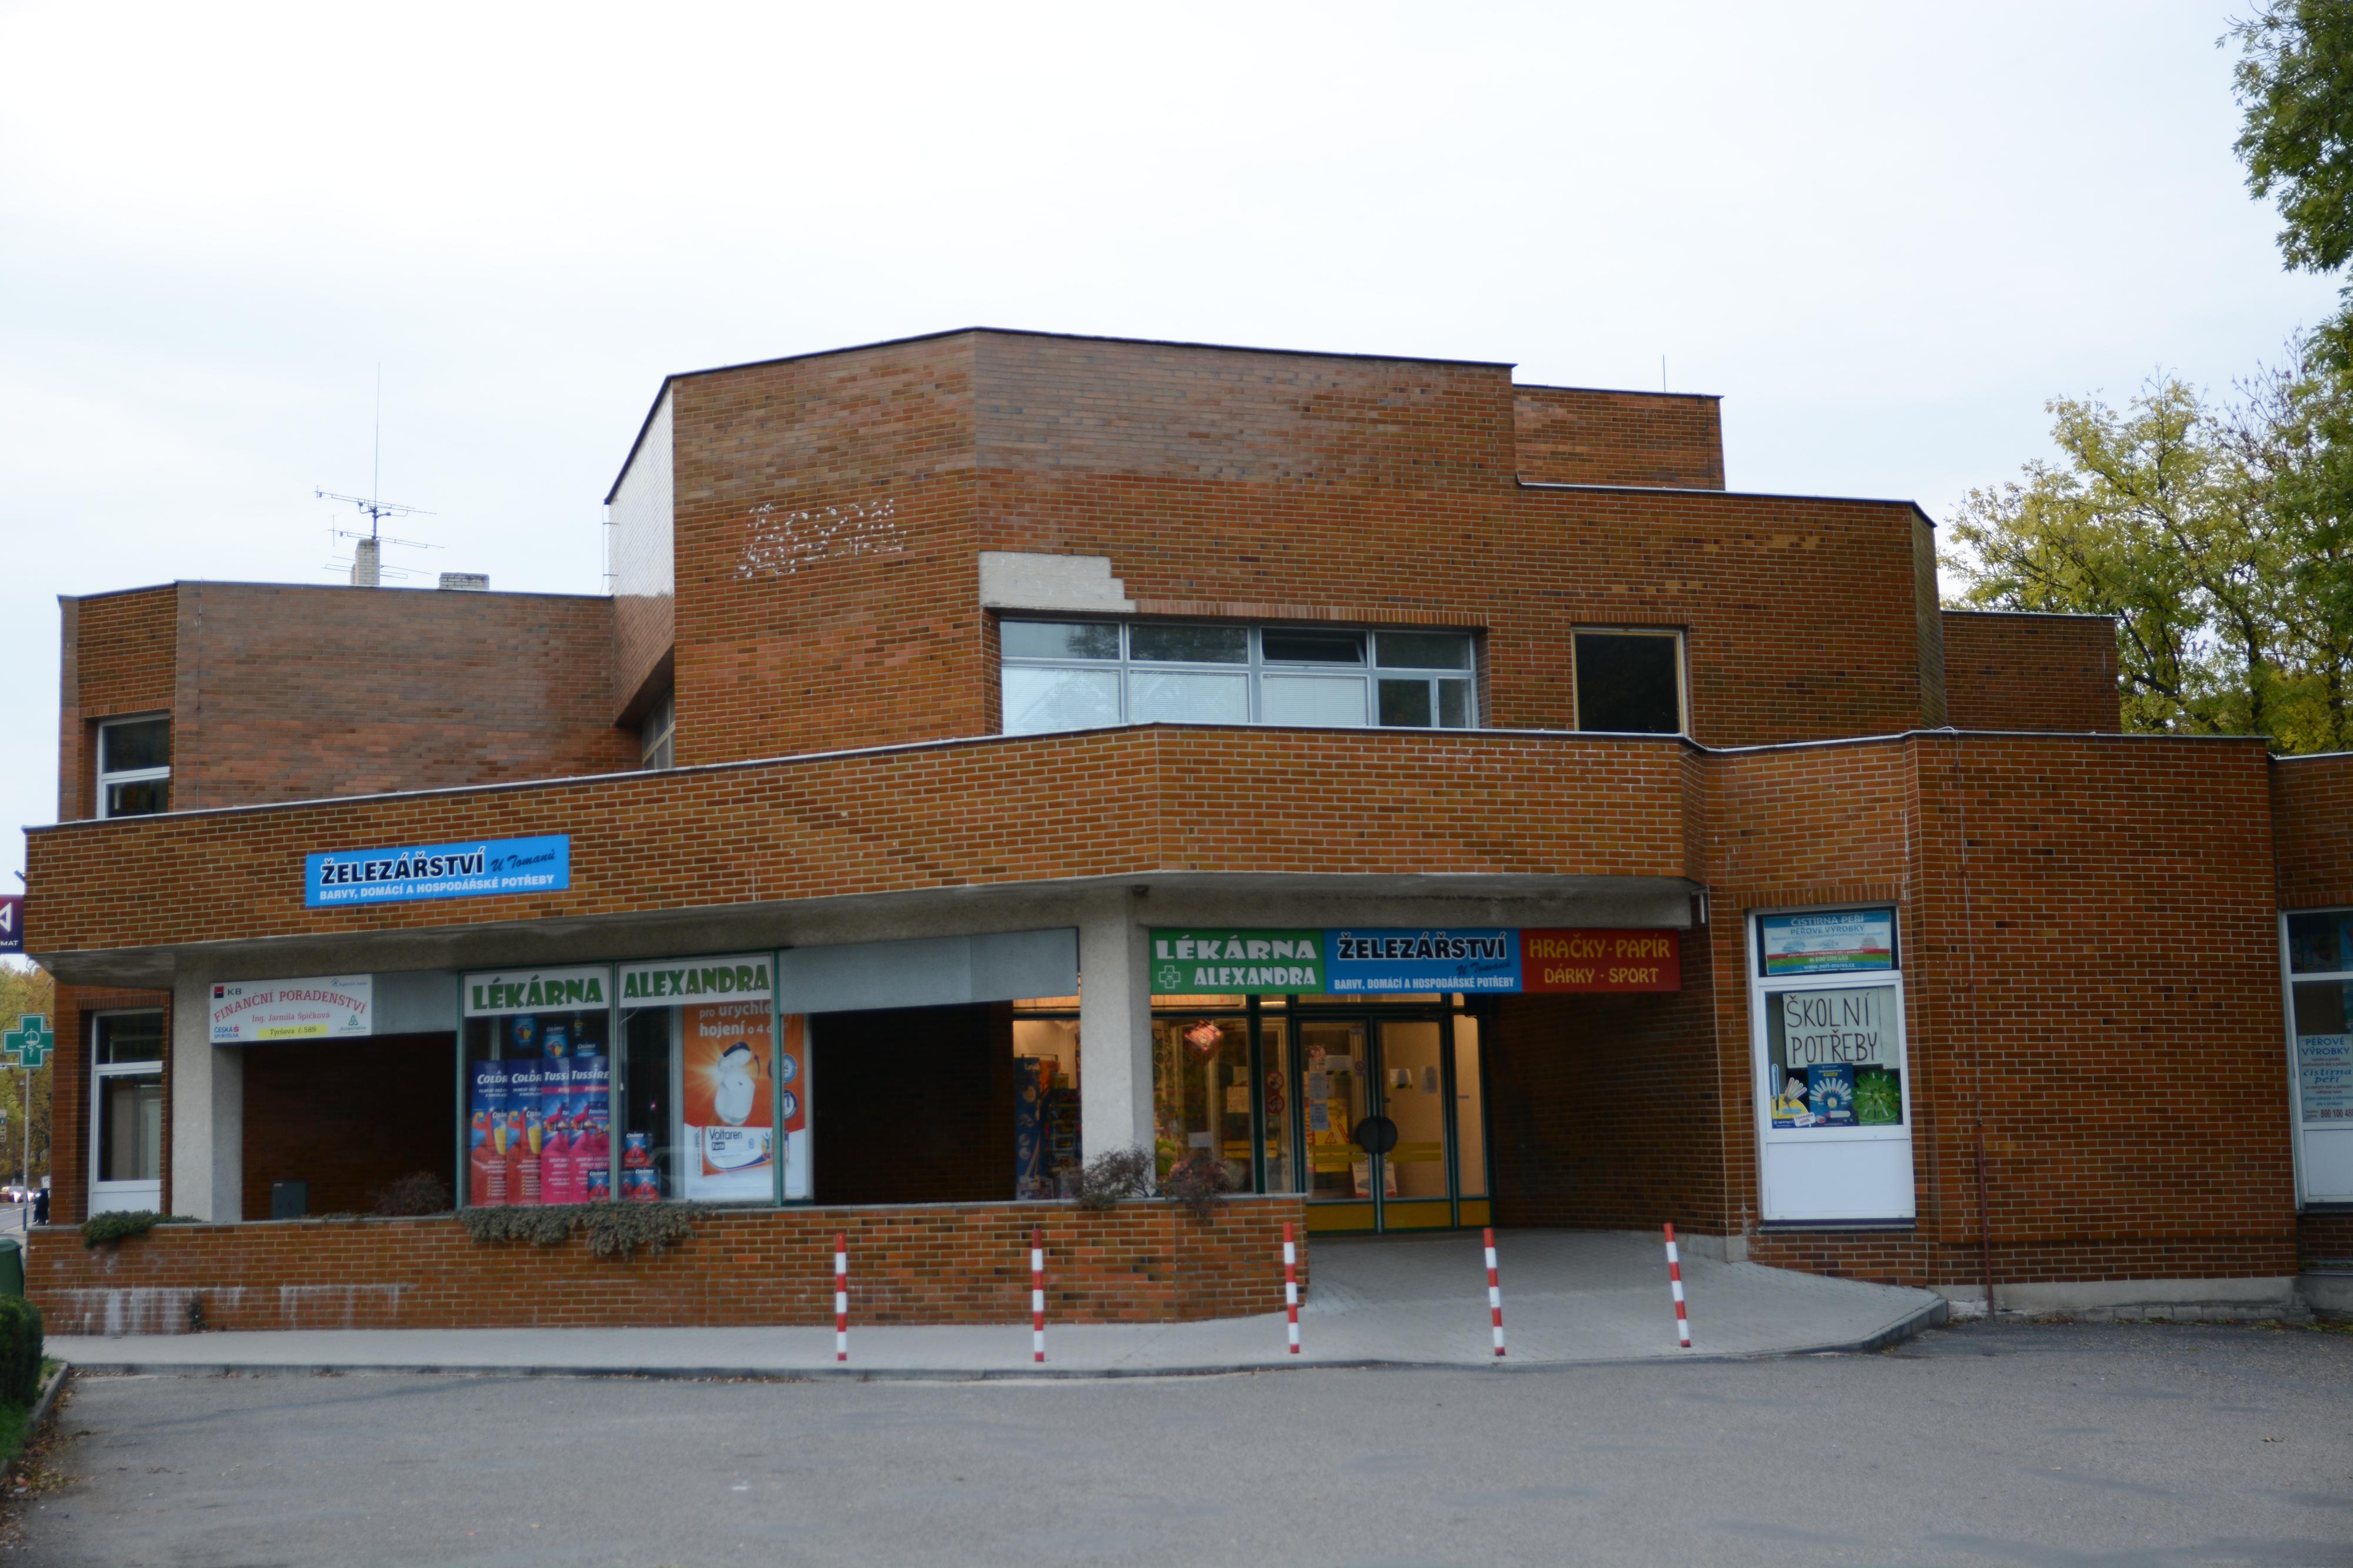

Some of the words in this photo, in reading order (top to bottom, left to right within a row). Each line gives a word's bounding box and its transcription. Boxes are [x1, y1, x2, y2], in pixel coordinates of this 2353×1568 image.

[321, 846, 486, 886] ŽELEZÁŘSTVÍ
[491, 858, 504, 872] U
[508, 849, 555, 869] Tomanů
[320, 889, 358, 900] BARVY,
[361, 883, 404, 897] DOMÁCÍ
[406, 885, 414, 893] A
[417, 877, 498, 893] HOSPODÁŘSKÉ
[501, 874, 555, 888] POTŘEBY
[1156, 935, 1317, 959] LÉKÁRNA
[1337, 932, 1507, 960] ŽELEZÁŘSTVÍ
[1194, 967, 1316, 985] ALEXANDRA
[1334, 979, 1365, 990] BARVY,
[1367, 976, 1402, 989] DOMÁCÍ
[1404, 979, 1411, 988] A
[1413, 975, 1475, 988] HOSPODÁŘSKÉ
[1477, 975, 1514, 987] POTŘEBY
[1544, 963, 1595, 983] DÁRKY
[1609, 968, 1659, 983] SPORT
[472, 974, 603, 1010] LÉKÁRNA
[624, 964, 770, 998] ALEXANDRA
[214, 989, 273, 1023] FINANČNÍ
[279, 990, 367, 1014] PORADENSTVÍ
[699, 1009, 715, 1019] pro
[1787, 992, 1871, 1027] ŠKOLNÍ
[268, 1013, 294, 1021] Jarmila
[298, 1011, 329, 1020] Špičková
[270, 1028, 294, 1036] Tyršova
[699, 1021, 745, 1039] hojení
[757, 1025, 764, 1033] 4
[1791, 1029, 1877, 1064] POTŘEBY
[2301, 1046, 2349, 1055] VÝROBKY
[2321, 1109, 2331, 1117] 800
[2333, 1109, 2343, 1117] 100
[709, 1128, 742, 1140] Voltaren
